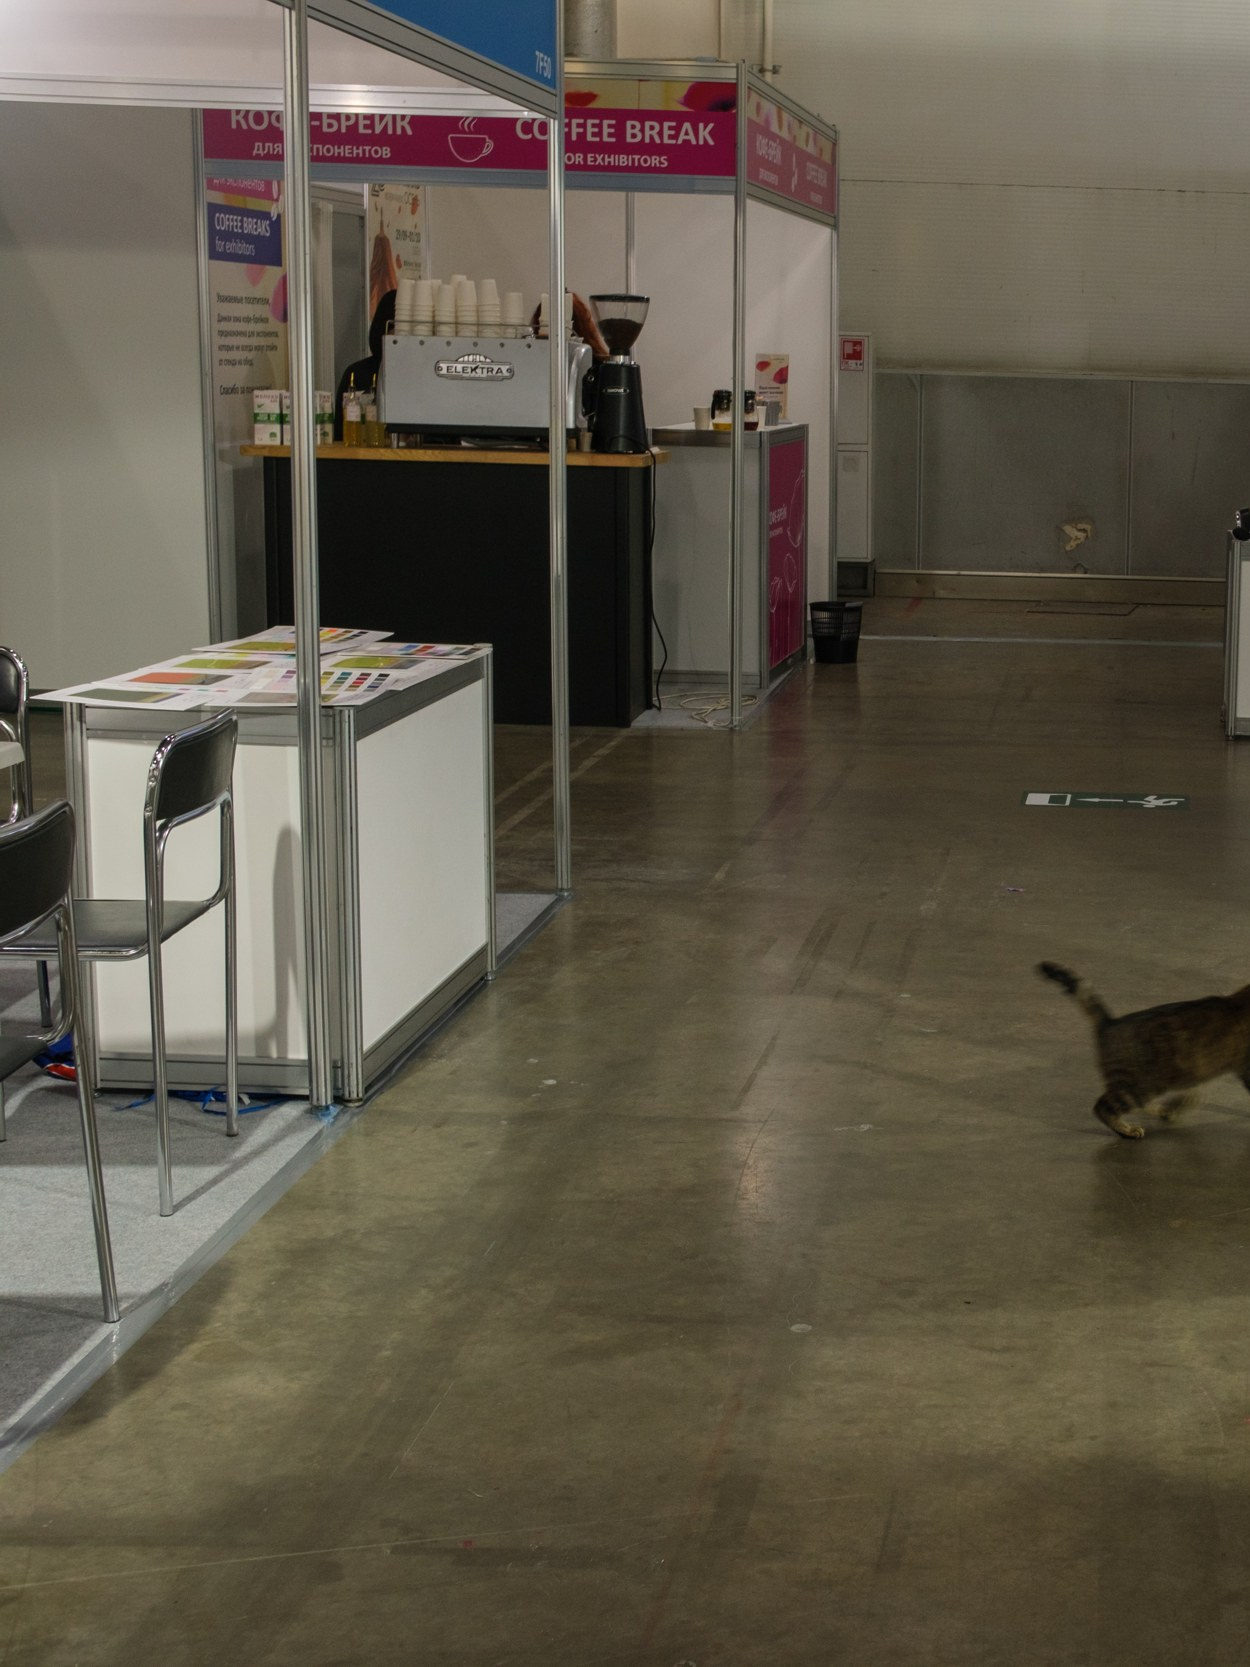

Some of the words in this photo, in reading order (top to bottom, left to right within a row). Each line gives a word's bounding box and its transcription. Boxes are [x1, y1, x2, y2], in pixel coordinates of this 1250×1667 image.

[535, 50, 551, 79] 7F50
[626, 120, 715, 146] BREAK
[252, 143, 282, 156] ДЛЯ
[564, 152, 584, 165] OR
[587, 153, 668, 168] EXHIBITORS
[215, 213, 242, 233] COFFEE
[243, 217, 271, 237] BREAKS
[215, 236, 225, 252] for
[225, 239, 255, 256] exhibitors
[446, 364, 504, 375] ELEKTRA
